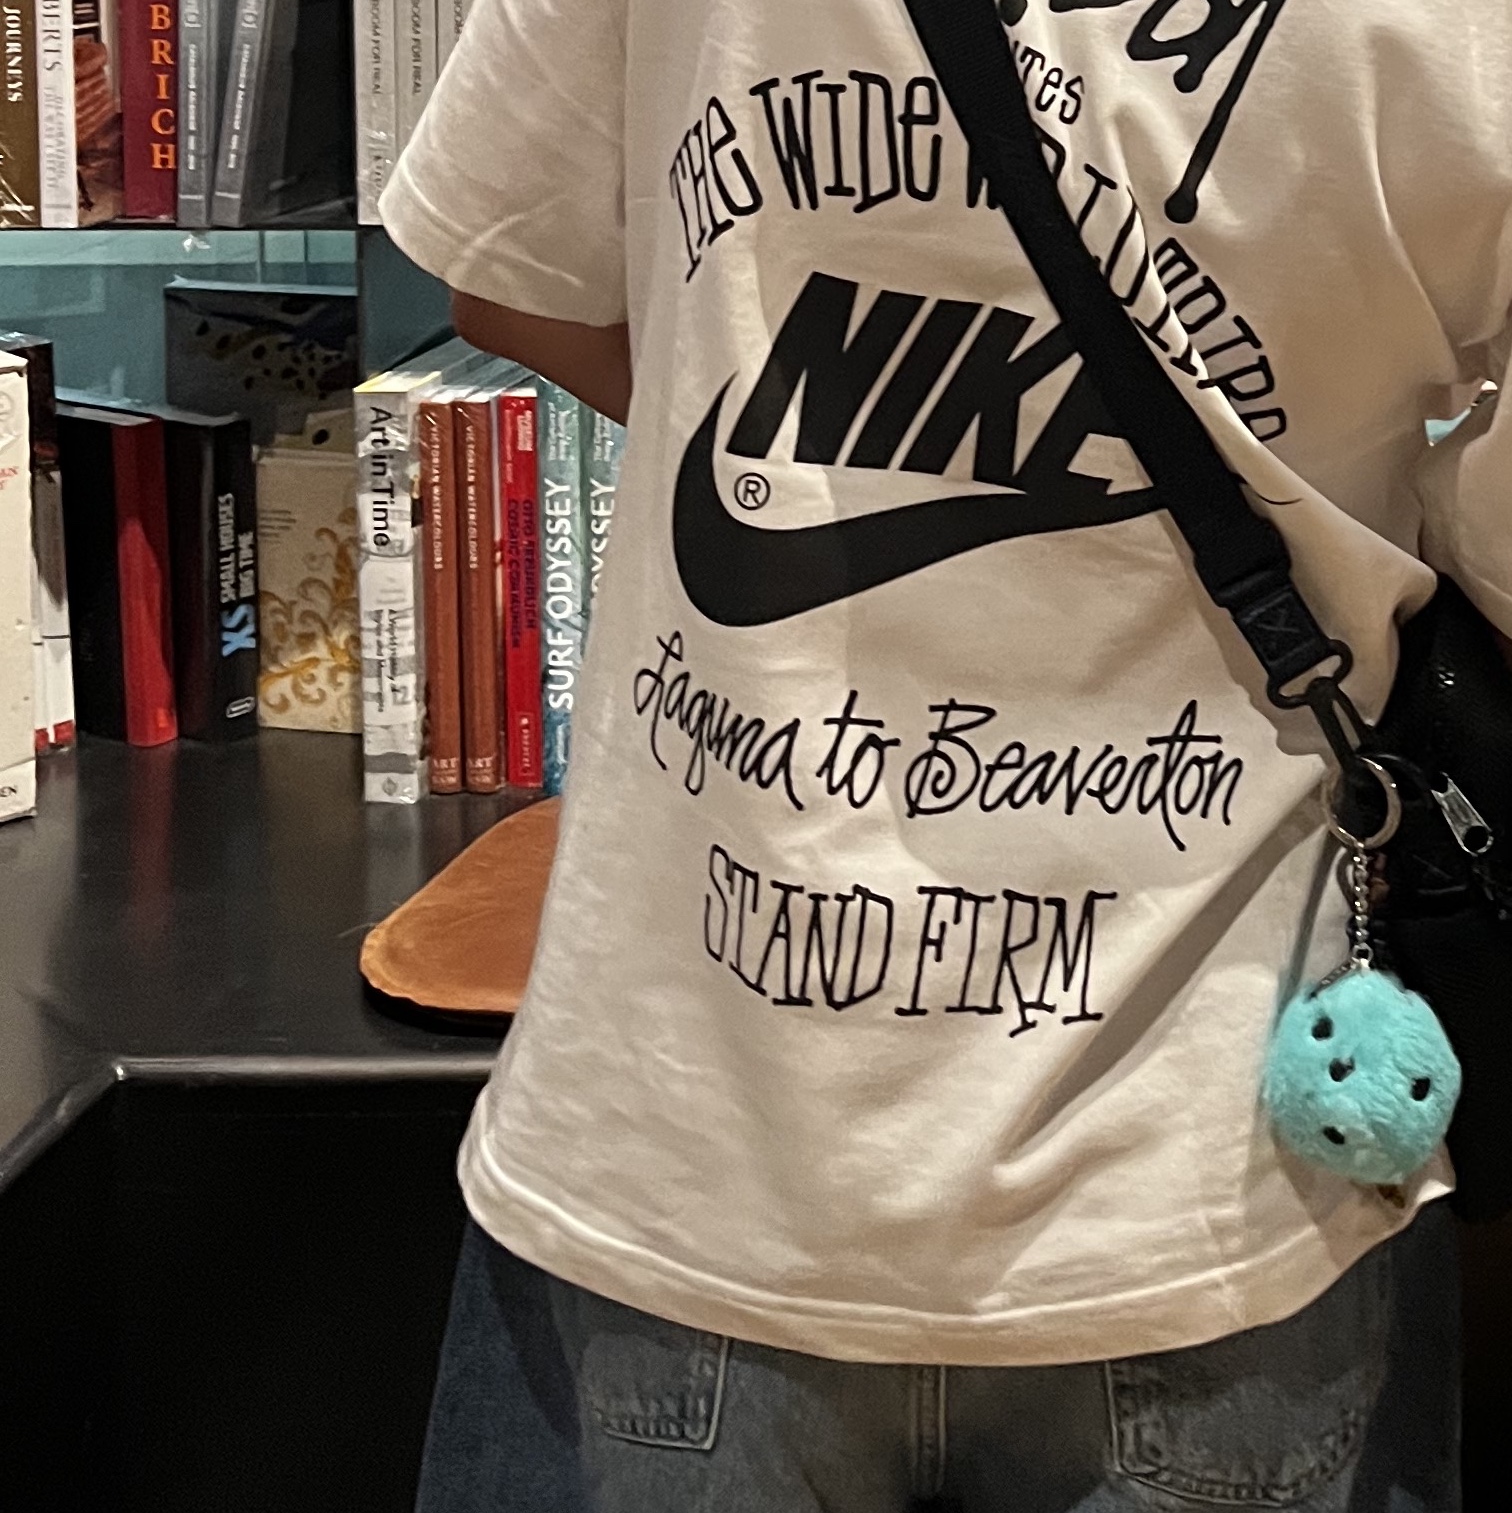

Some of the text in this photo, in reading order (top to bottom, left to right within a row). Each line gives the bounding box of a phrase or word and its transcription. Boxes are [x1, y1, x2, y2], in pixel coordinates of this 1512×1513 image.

[371, 406, 393, 548] Art in Time
[432, 426, 444, 570] VICTORIAN WATERCOLOURS
[545, 478, 572, 620] ODYSSEY
[222, 604, 255, 656] XS
[545, 631, 574, 711] SURF
[634, 630, 1244, 852] Laguna to Beaverton
[704, 844, 1118, 1038] STAND FIRM
